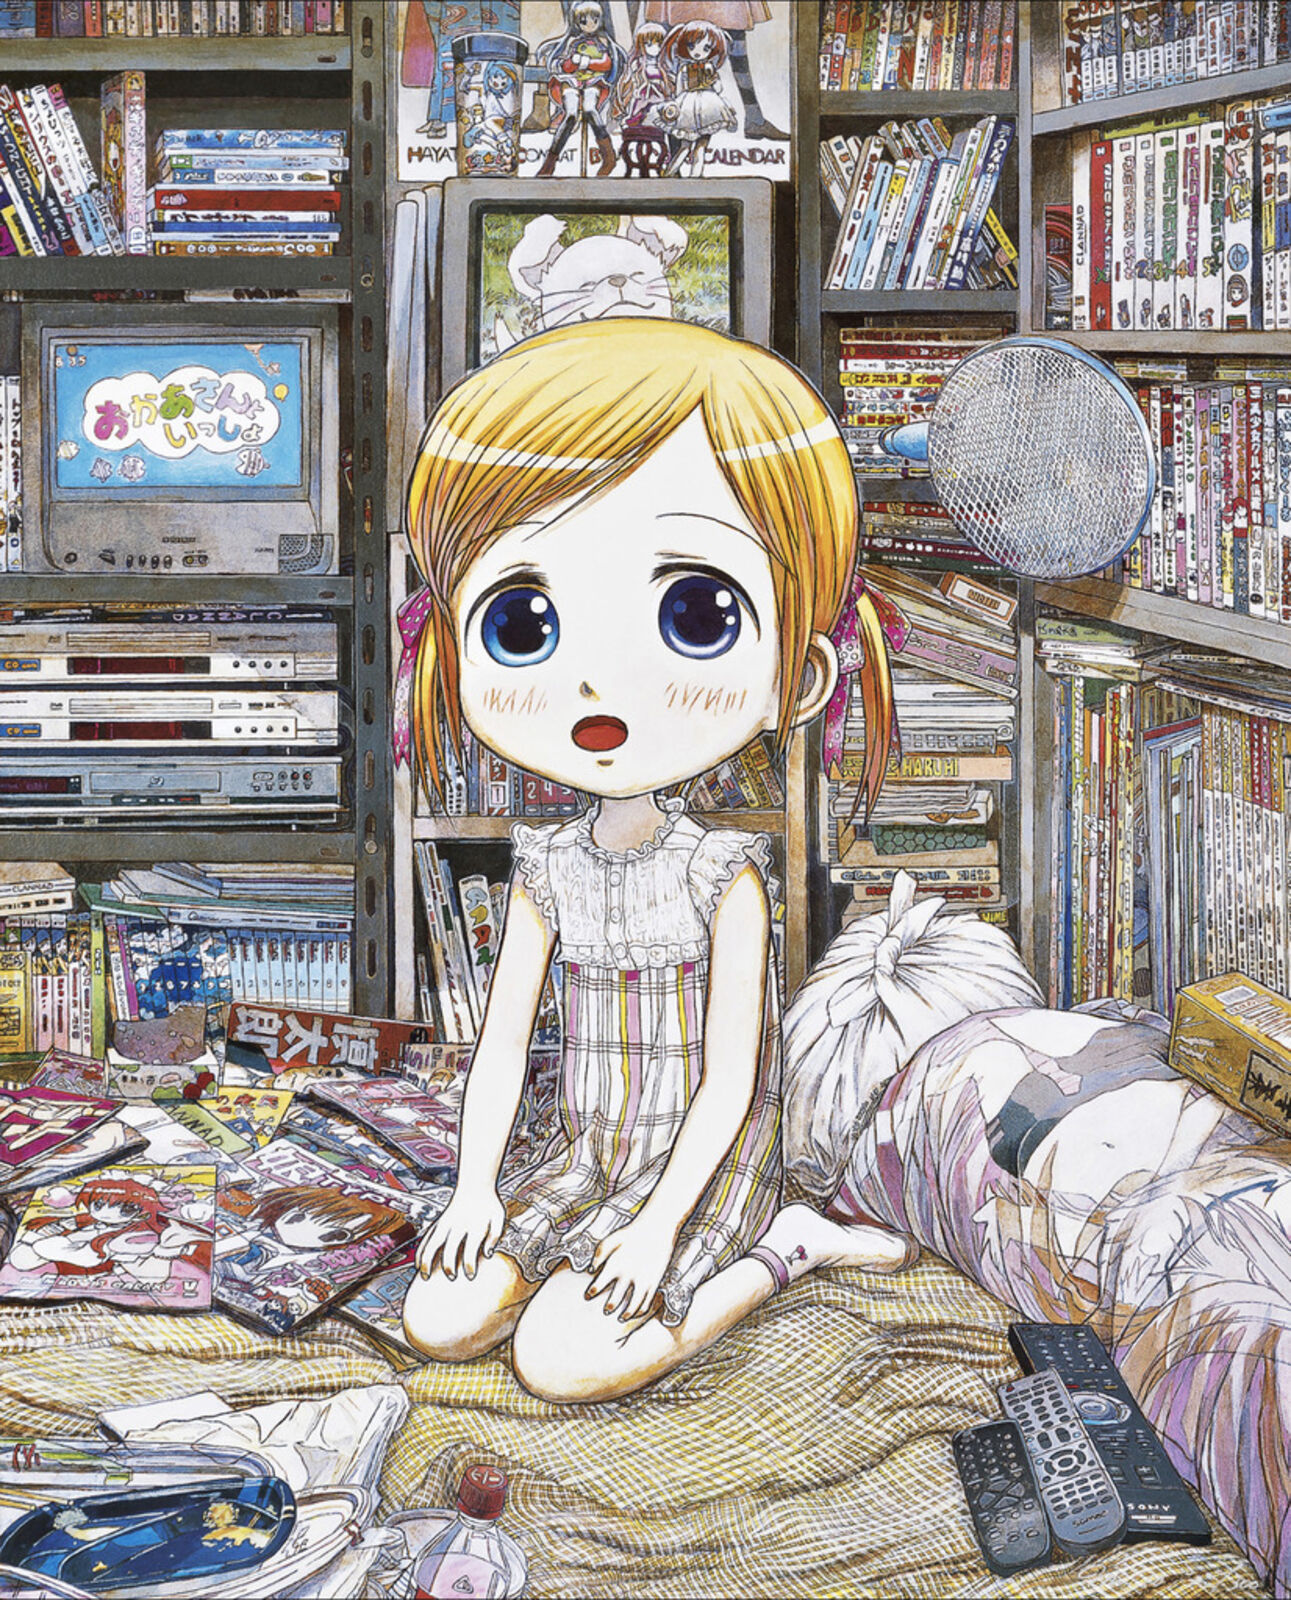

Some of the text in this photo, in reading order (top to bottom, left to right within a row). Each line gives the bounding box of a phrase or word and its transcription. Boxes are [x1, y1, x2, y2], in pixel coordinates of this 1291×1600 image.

[1076, 204, 1086, 266] CLANNAD
[164, 414, 263, 448] いっしょ
[172, 608, 282, 622] CLANNAD
[901, 757, 960, 777] HARUHI
[526, 781, 537, 799] 2
[543, 779, 553, 796] 4
[12, 882, 54, 893] CLANNAD
